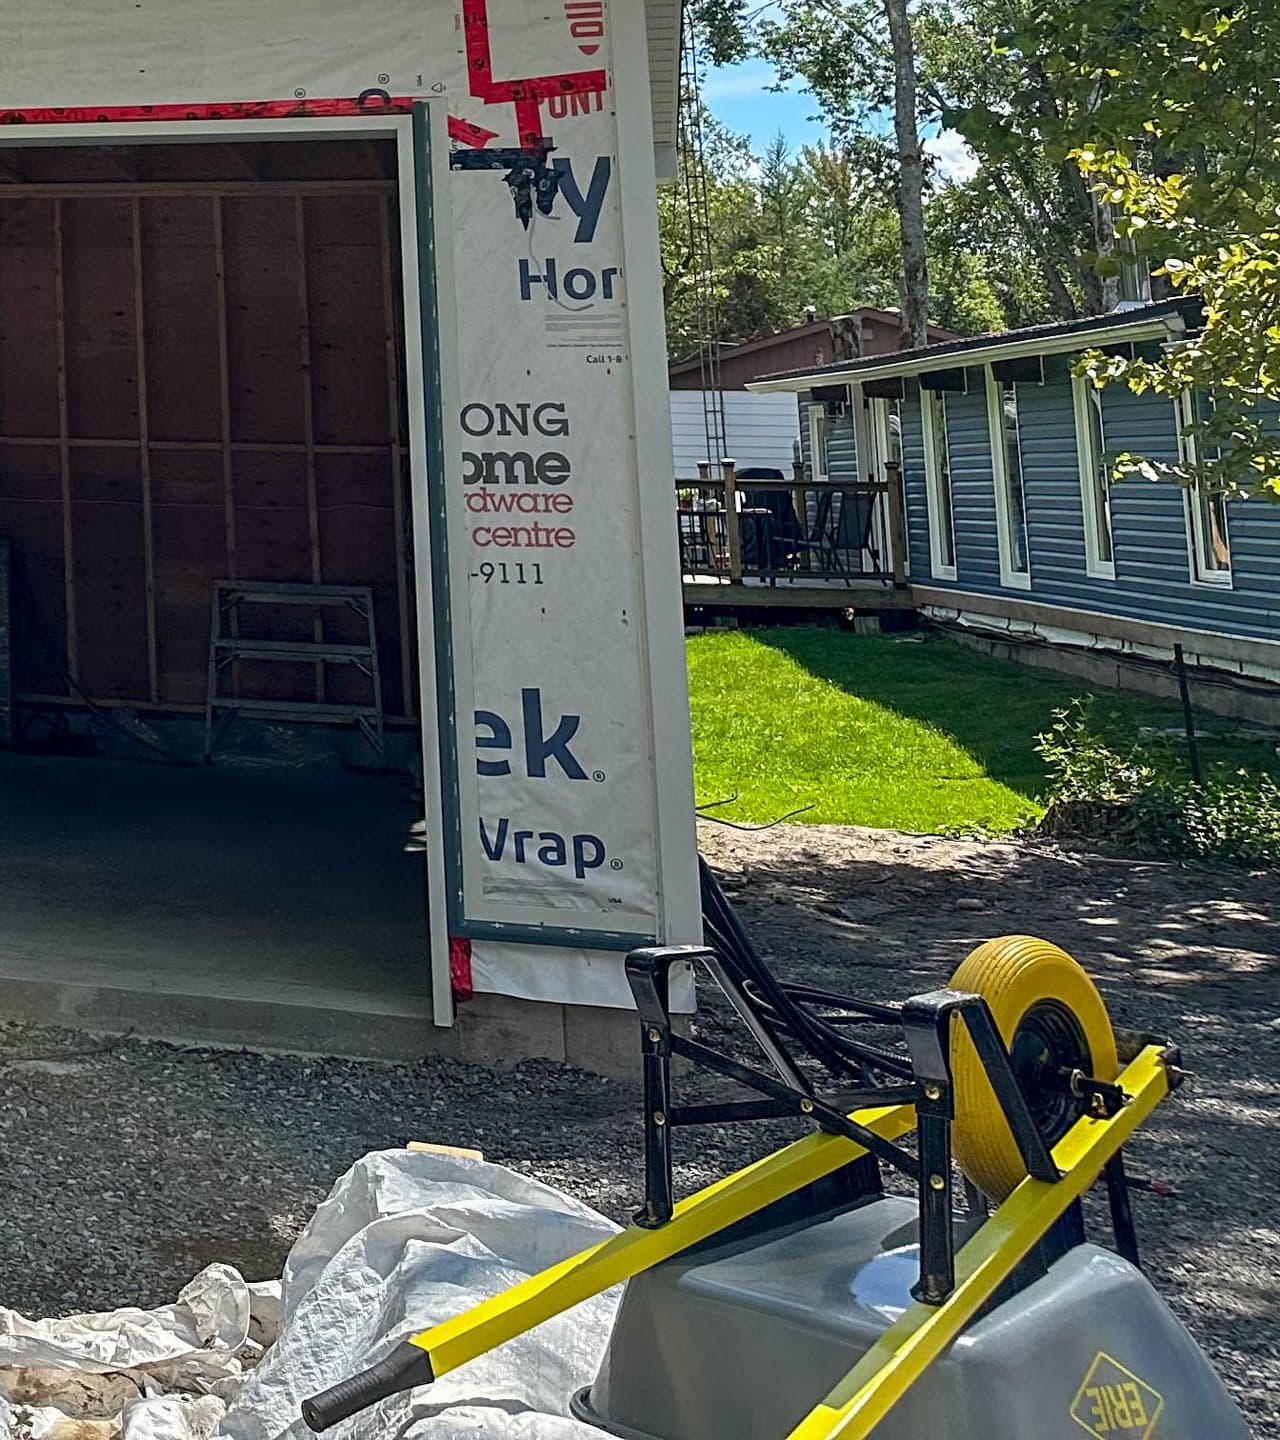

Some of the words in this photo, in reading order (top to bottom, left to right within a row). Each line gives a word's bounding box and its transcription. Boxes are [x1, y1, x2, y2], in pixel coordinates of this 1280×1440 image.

[464, 486, 574, 514] dware
[472, 520, 576, 548] centre
[1085, 1381, 1149, 1432] ERIE
